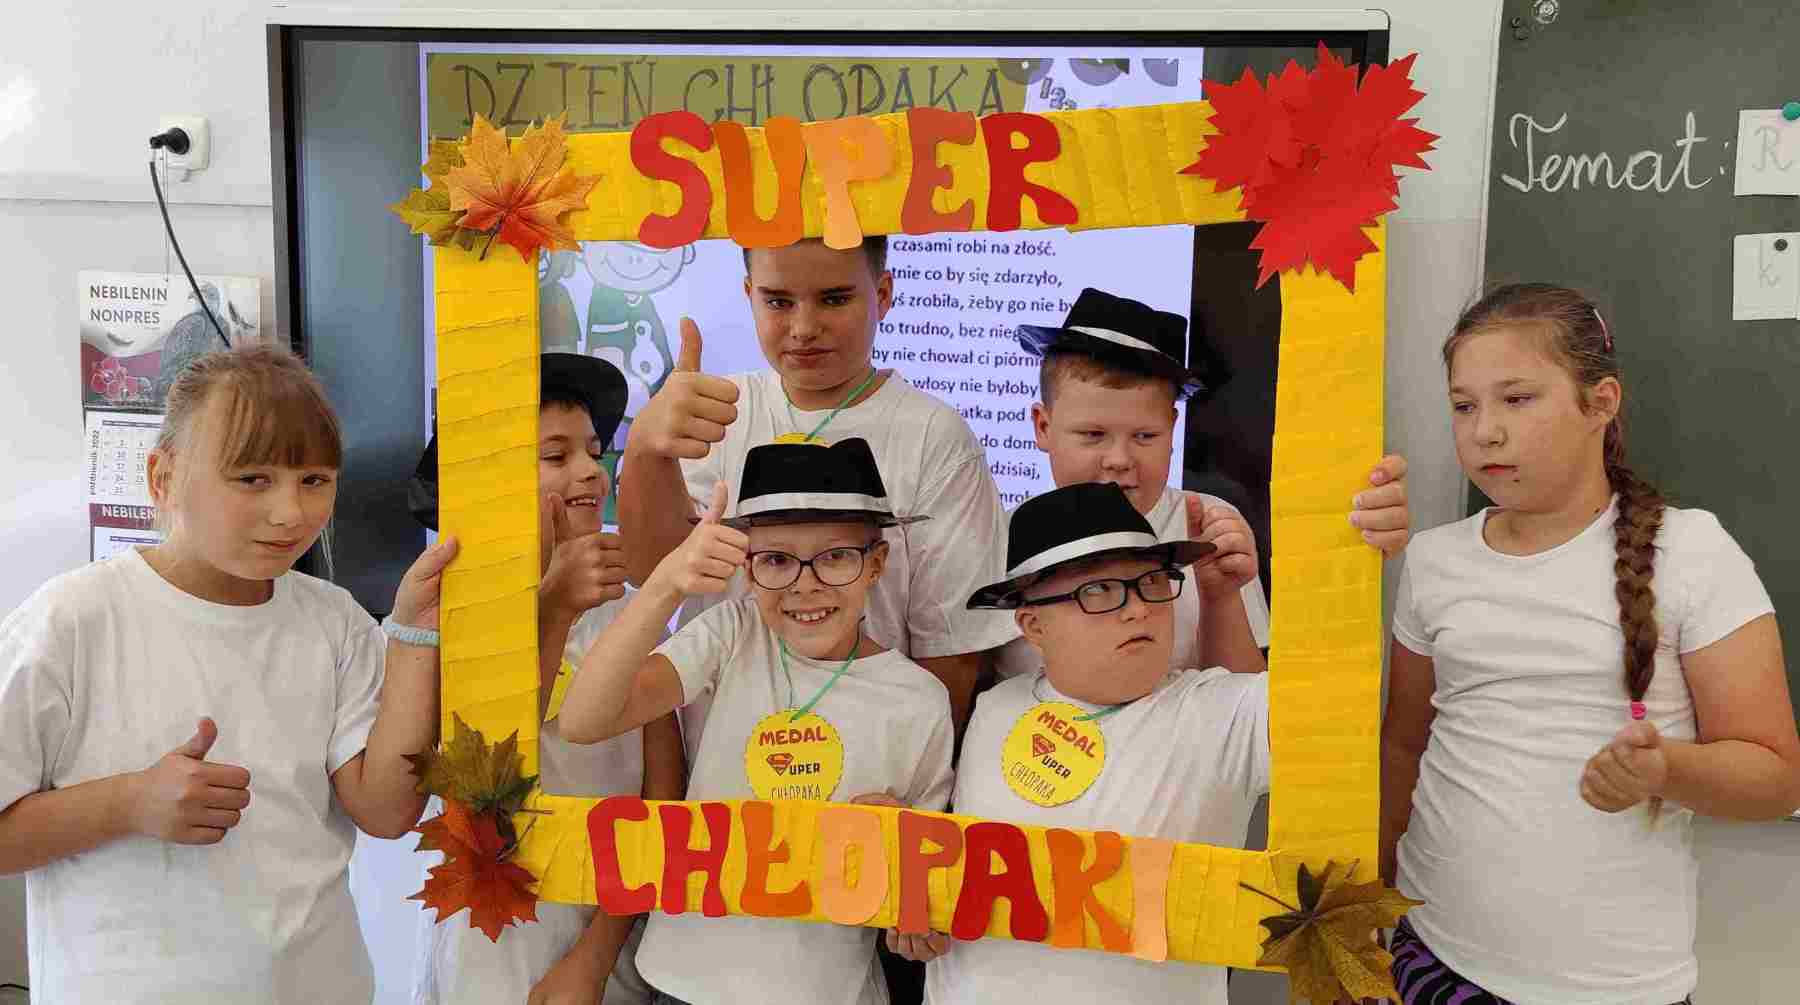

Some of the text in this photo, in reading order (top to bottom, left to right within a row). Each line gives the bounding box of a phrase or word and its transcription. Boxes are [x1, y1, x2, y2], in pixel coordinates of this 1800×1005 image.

[630, 108, 1079, 250] SUPER
[892, 237, 1057, 258] czasami robi na złość.
[890, 265, 922, 280] tnie
[924, 269, 943, 281] co
[946, 266, 966, 284] by
[968, 267, 990, 285] się
[89, 285, 168, 301] NEBILENIN
[967, 295, 1004, 314] żeby
[1007, 299, 1026, 315] go
[1030, 297, 1054, 312] nie
[89, 308, 161, 324] NONPRES
[898, 321, 955, 340] trudno,
[958, 323, 985, 339] bez
[988, 325, 1022, 342] nieg
[892, 346, 916, 361] nie
[977, 350, 991, 364] ci
[993, 351, 1041, 368] piórni
[959, 376, 983, 392] nie
[996, 406, 1026, 424] pod
[980, 433, 1037, 449] do dom
[990, 460, 1041, 480] dzisiaj,
[101, 505, 157, 520] NEBILEN
[759, 725, 828, 747] MEDAL
[1032, 710, 1097, 758] MEDAL
[586, 795, 1175, 963] CHŁOPAKI
